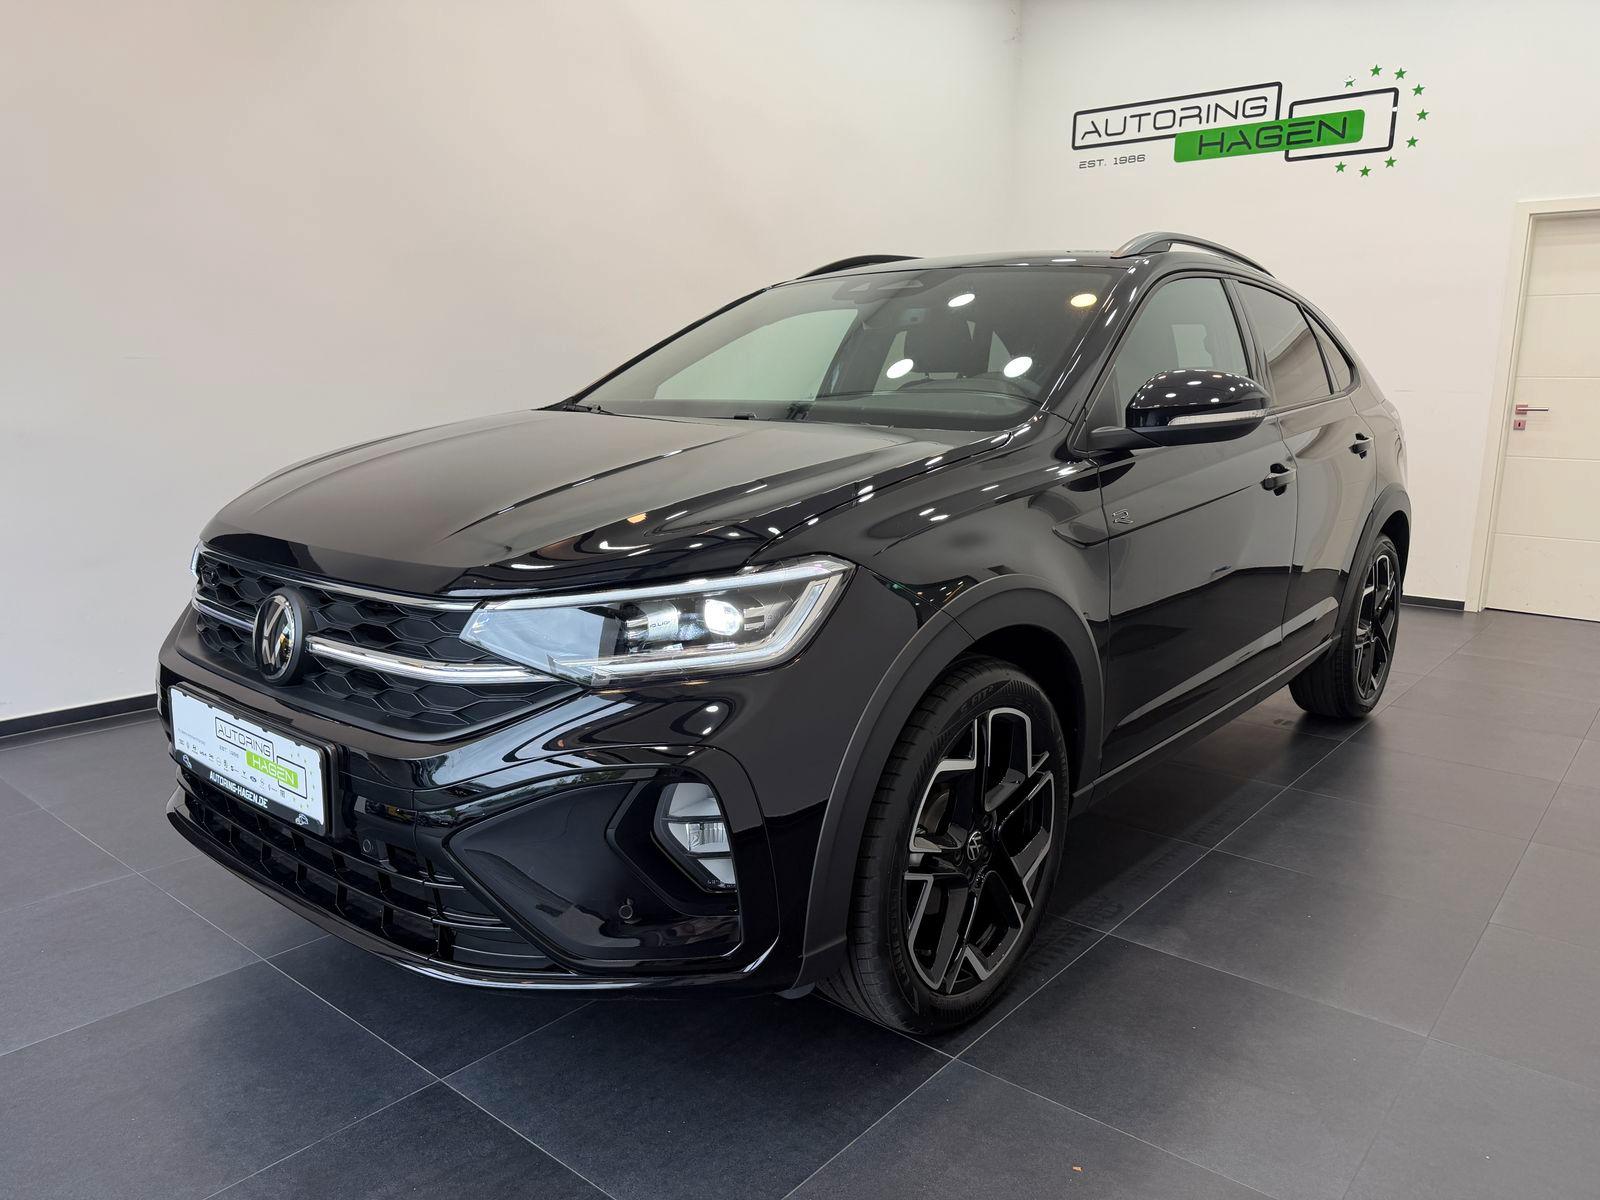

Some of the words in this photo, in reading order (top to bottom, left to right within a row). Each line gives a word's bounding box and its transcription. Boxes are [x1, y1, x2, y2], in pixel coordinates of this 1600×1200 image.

[1081, 96, 1268, 140] AUTORING
[1198, 116, 1347, 156] HAGEN
[1078, 158, 1107, 169] EST.
[1113, 154, 1146, 165] 1986
[217, 724, 271, 757] AUTORING
[252, 754, 296, 786] HAGEN
